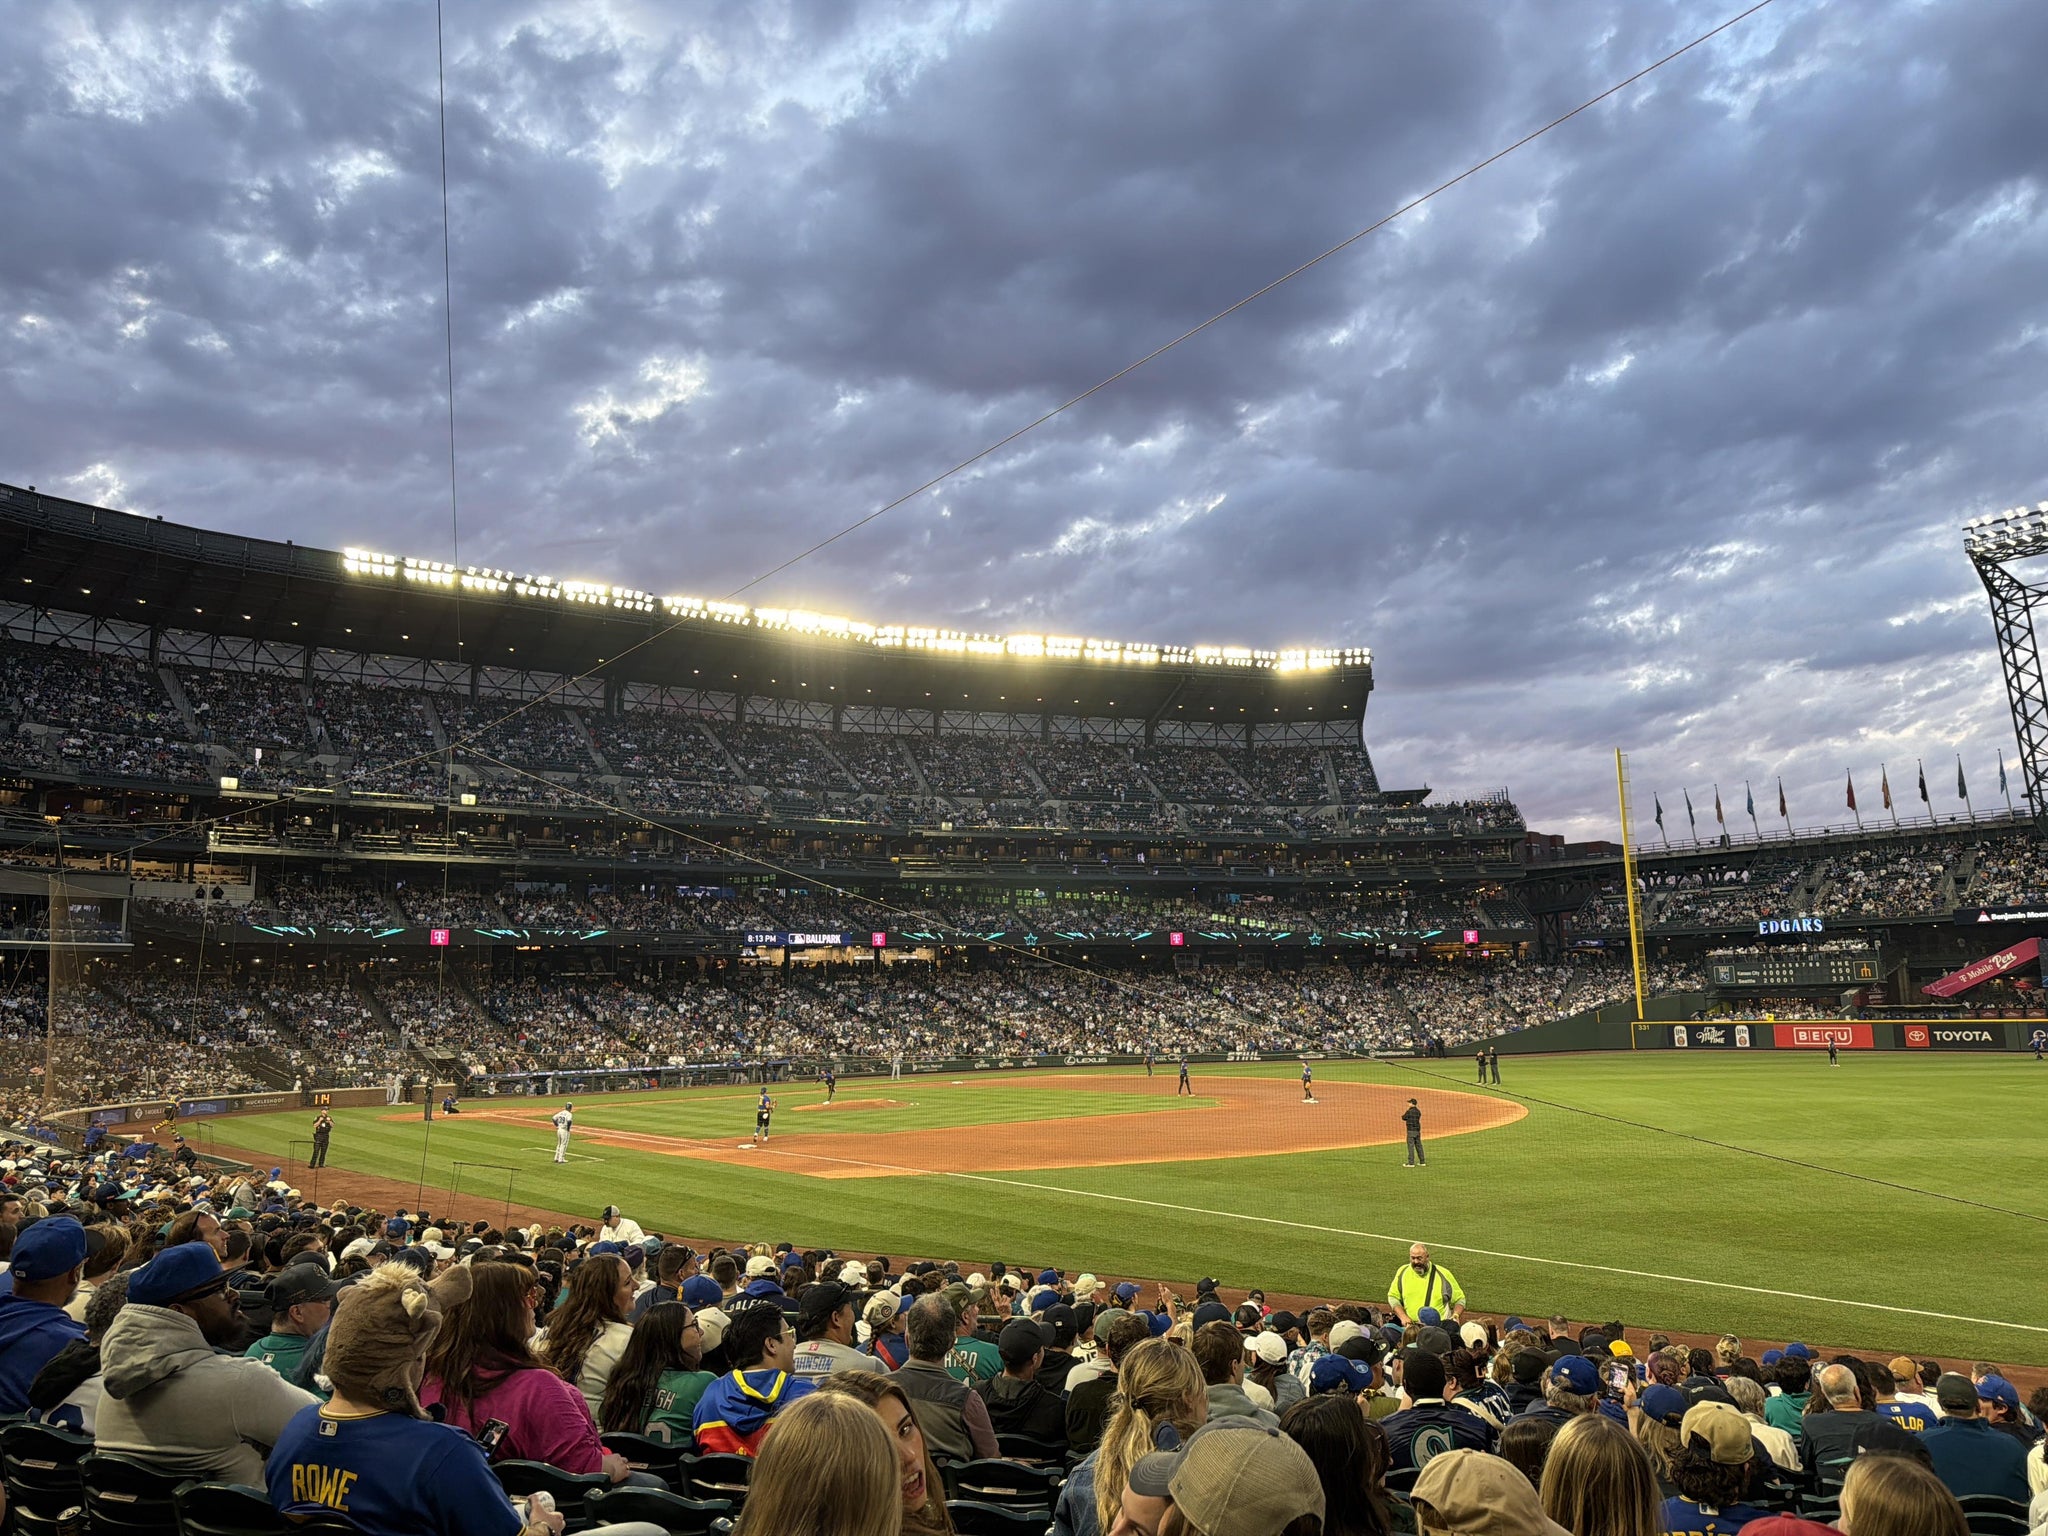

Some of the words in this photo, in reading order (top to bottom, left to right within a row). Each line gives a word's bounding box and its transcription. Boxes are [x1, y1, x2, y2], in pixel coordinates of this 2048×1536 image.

[1991, 912, 2026, 921] Benjamin
[747, 934, 764, 943] 8:13
[765, 934, 777, 943] PM
[806, 934, 841, 944] BALLPARK
[1967, 964, 1994, 980] Mobile
[1675, 1027, 1686, 1036] Lite
[1696, 1030, 1725, 1043] Miller
[1736, 1027, 1748, 1036] Lite
[1933, 1031, 1992, 1041] TOYOTA
[1226, 1051, 1262, 1061] STIHL
[794, 1355, 834, 1372] OHNSON
[292, 1463, 358, 1512] ROWE
